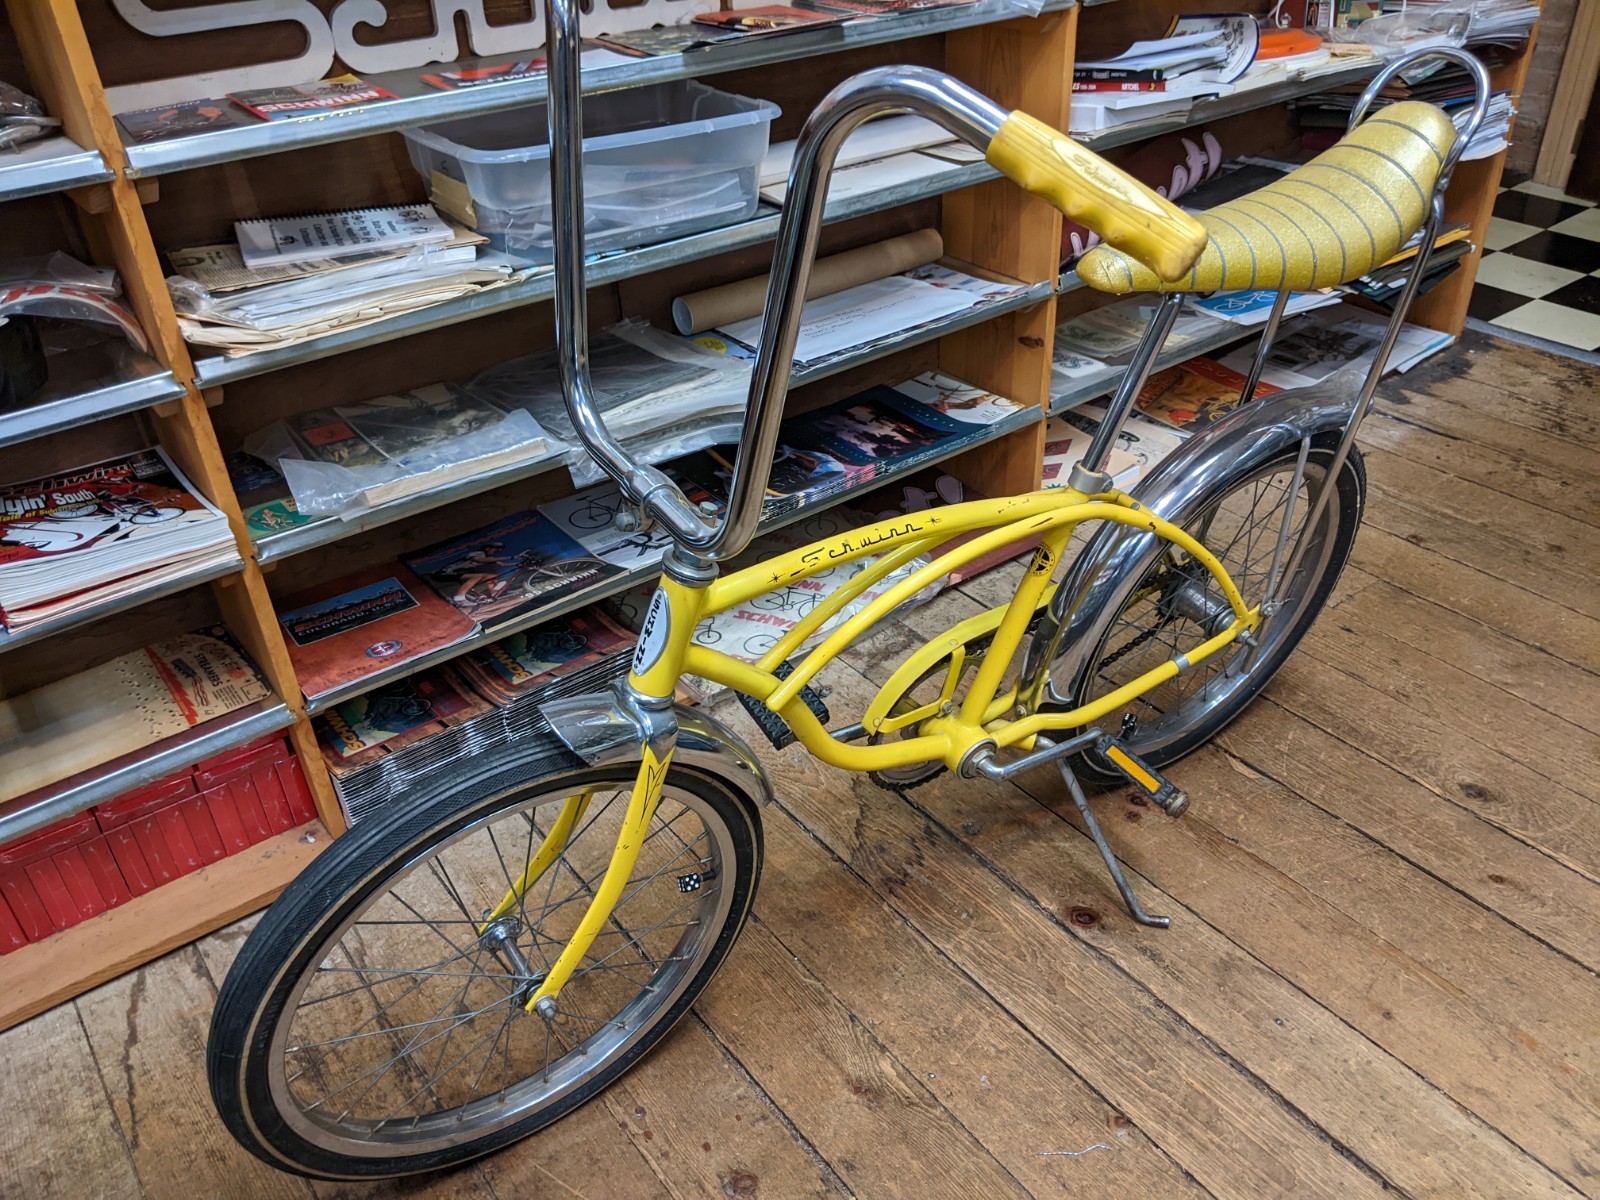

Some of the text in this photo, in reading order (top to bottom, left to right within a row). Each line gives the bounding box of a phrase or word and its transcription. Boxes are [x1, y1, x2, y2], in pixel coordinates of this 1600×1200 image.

[257, 90, 380, 113] SCHWINN
[52, 488, 96, 506] South
[790, 522, 924, 578] Schwinn
[548, 568, 598, 591] SCHWINN
[294, 590, 402, 633] SCHWINN
[733, 609, 810, 631] SCHWI
[193, 653, 224, 687] STREAMERS
